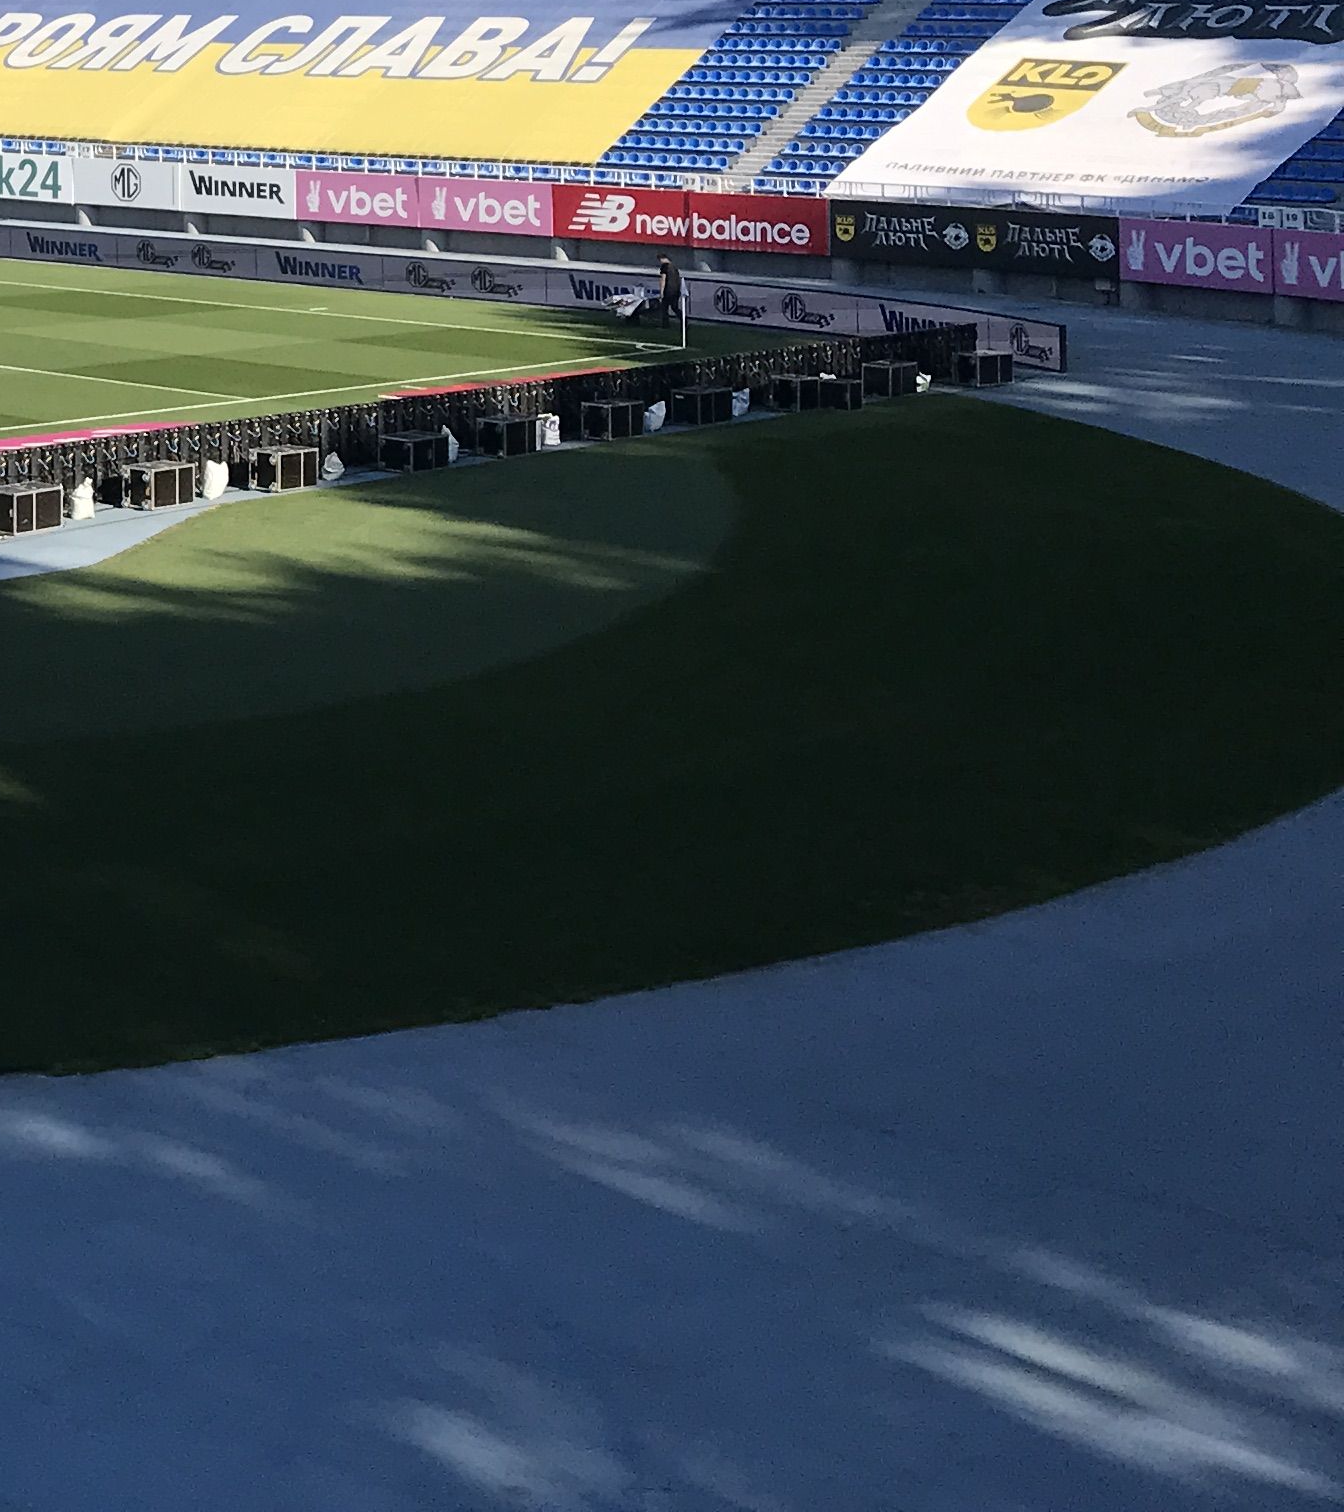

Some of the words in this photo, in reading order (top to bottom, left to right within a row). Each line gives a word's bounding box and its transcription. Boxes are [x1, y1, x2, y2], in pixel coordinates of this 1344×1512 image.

[215, 14, 658, 83] СЛАВА!
[188, 170, 285, 204] WINNER
[990, 169, 1075, 183] ПАРТНЕР
[1079, 173, 1106, 183] ФК
[327, 185, 408, 219] vbet
[454, 192, 541, 227] vbet
[636, 213, 690, 237] new
[692, 213, 810, 245] balance
[861, 211, 939, 237] ПАЛЬНЕ
[1005, 220, 1087, 248] ПАЛЬНЕ
[26, 232, 104, 261] WINNER
[872, 232, 929, 251] ЛЮТІ
[1015, 243, 1074, 264] ЛЮТІ
[275, 251, 363, 285] WINNER
[1154, 237, 1265, 283] vbet
[1309, 248, 1344, 291] v
